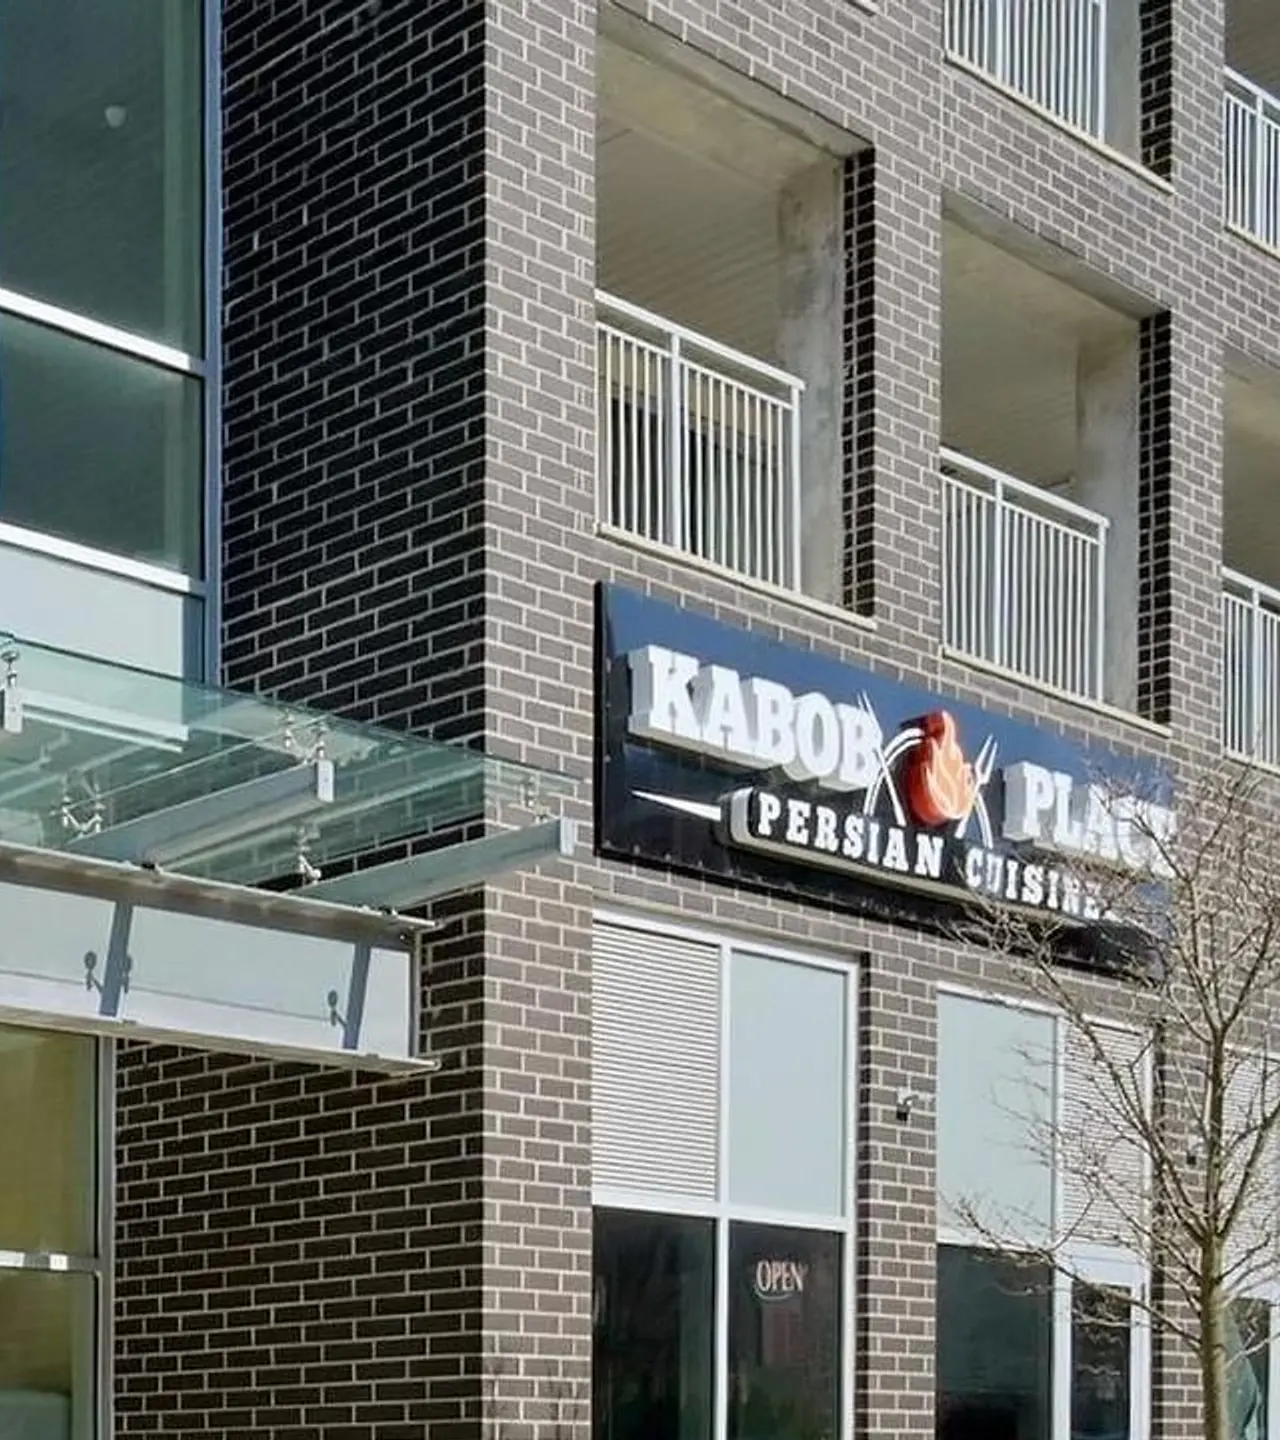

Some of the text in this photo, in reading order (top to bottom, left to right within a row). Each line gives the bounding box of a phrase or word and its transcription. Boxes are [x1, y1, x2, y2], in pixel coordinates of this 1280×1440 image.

[629, 644, 883, 790] KABOB
[757, 791, 945, 878] PERSIAN
[756, 1260, 808, 1293] OPEN
